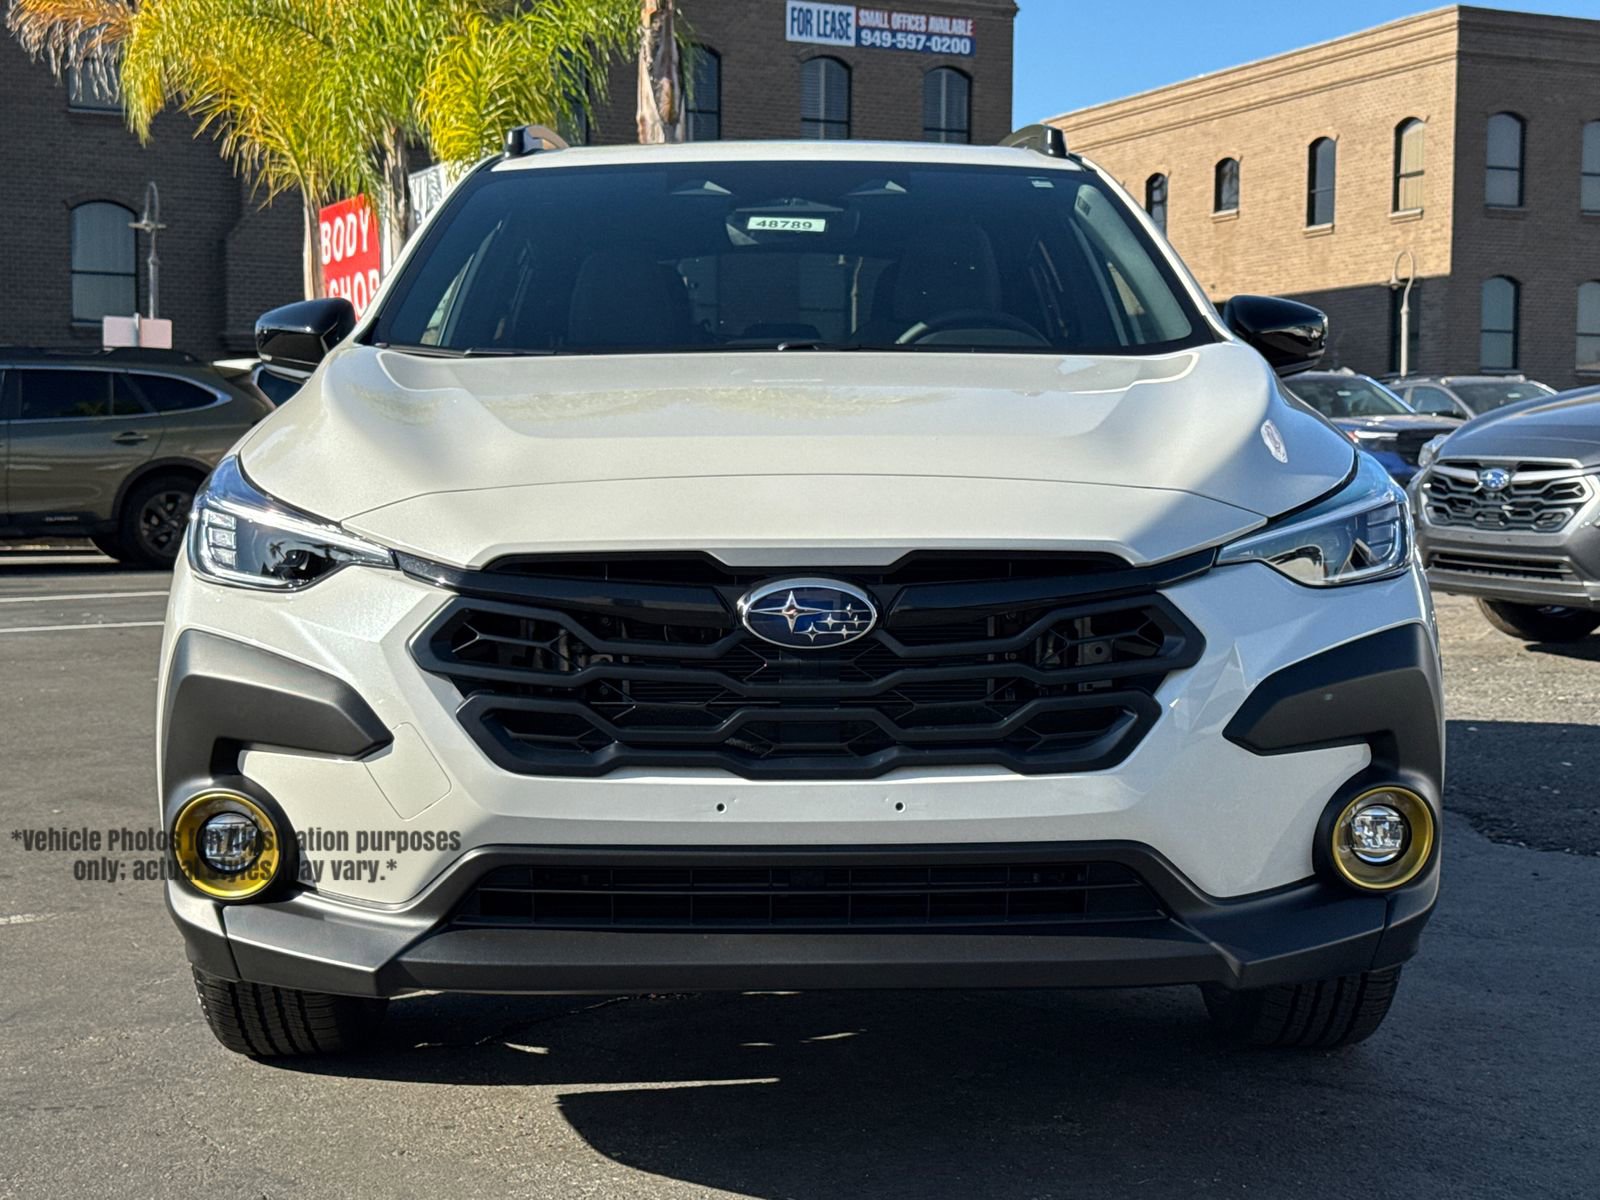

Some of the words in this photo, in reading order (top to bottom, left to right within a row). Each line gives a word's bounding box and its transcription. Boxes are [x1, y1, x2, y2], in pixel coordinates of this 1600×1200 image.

[791, 7, 813, 36] FOR
[817, 9, 851, 40] LEASE
[859, 9, 889, 28] SMALL
[891, 12, 927, 32] OFFICES
[928, 15, 973, 36] AVAILABLE
[860, 28, 971, 54] 949-597-0200
[320, 206, 371, 265] BODY
[756, 219, 813, 230] 48789
